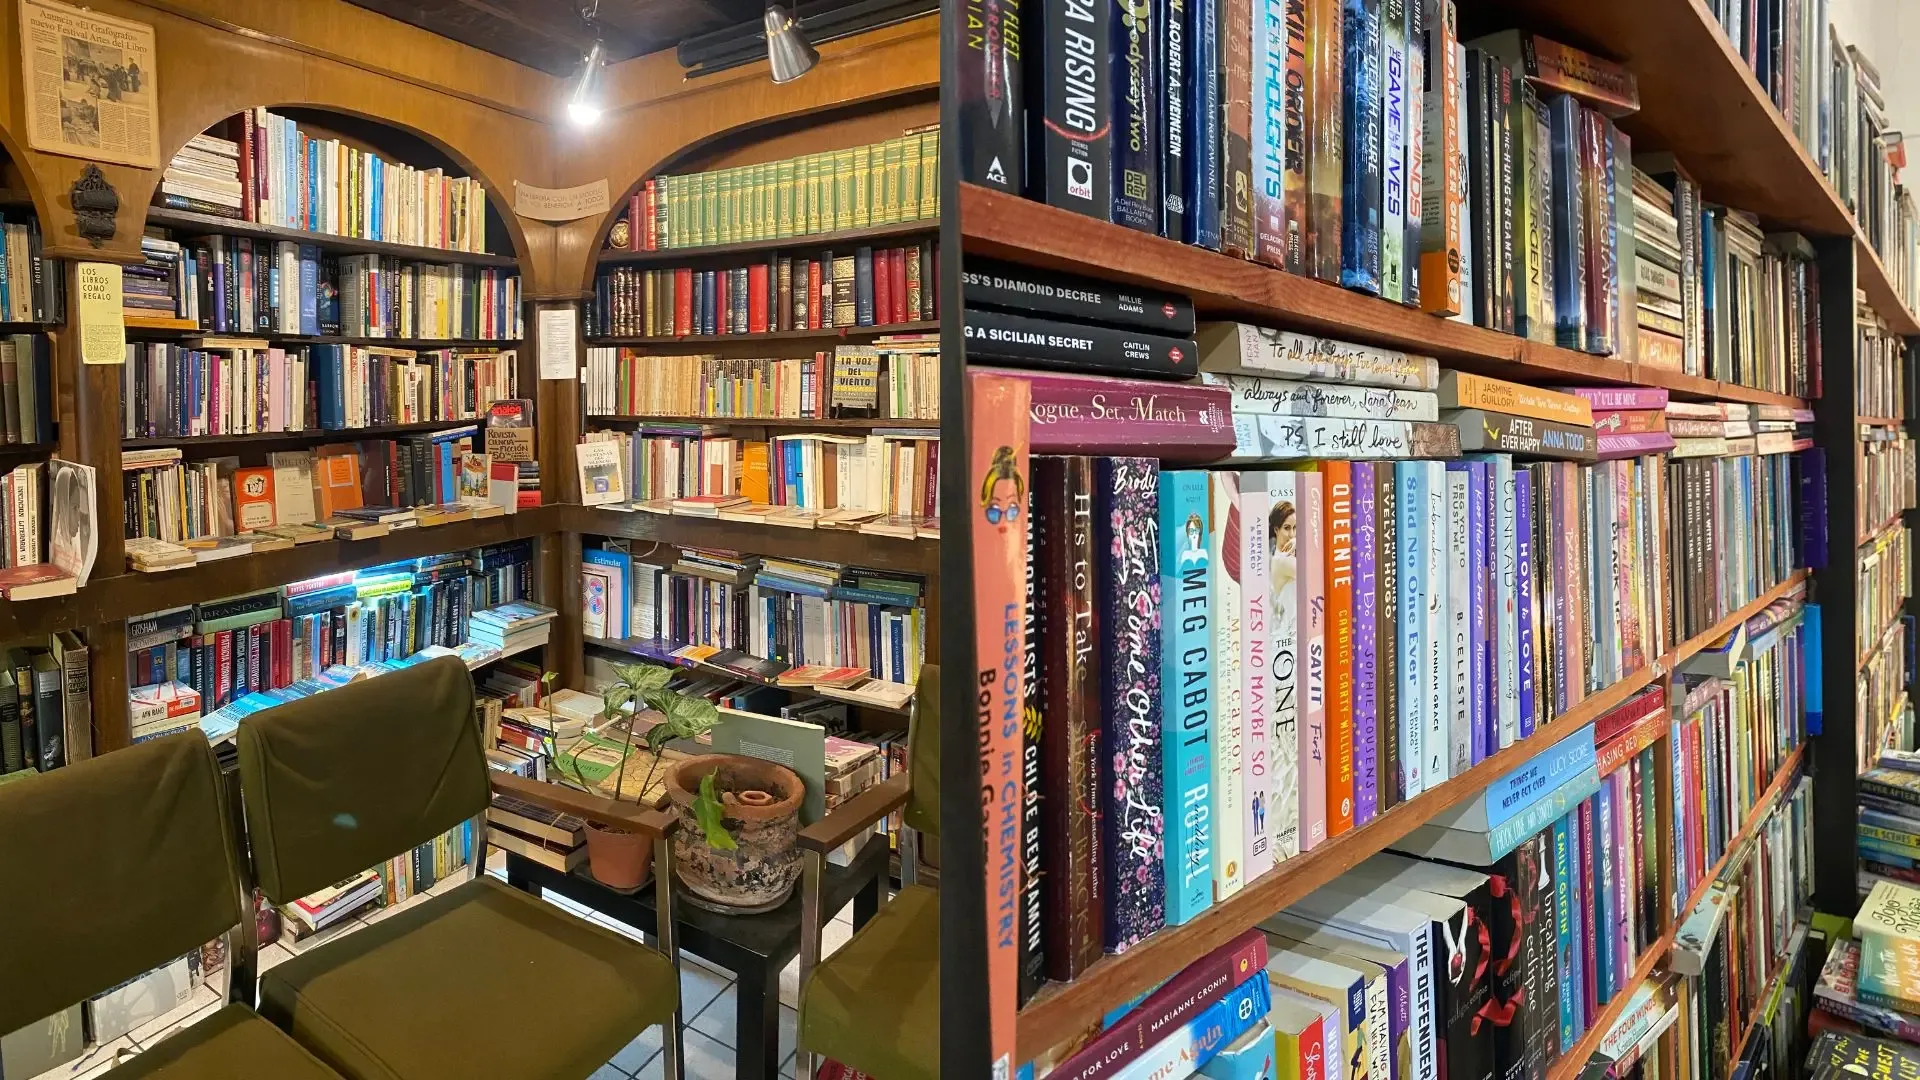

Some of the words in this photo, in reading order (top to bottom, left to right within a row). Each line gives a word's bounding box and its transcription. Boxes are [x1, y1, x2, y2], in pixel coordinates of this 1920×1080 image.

[57, 23, 88, 39] Festival
[112, 39, 124, 48] del
[126, 42, 147, 53] Libro
[1368, 12, 1379, 51] THE
[1065, 28, 1096, 134] RISING
[1368, 53, 1379, 118] DEATH
[1265, 47, 1281, 200] THOUGHTS
[1368, 121, 1379, 176] CURE
[1448, 115, 1457, 193] PLAYER
[986, 172, 1008, 185] ACE
[1069, 186, 1091, 199] orbit
[1126, 171, 1147, 187] DEL
[1126, 185, 1147, 199] REY
[1504, 152, 1512, 205] HUNGER
[1125, 214, 1148, 226] BOOKS
[1449, 200, 1457, 242] ONE
[1504, 207, 1512, 270] GAMES
[82, 276, 109, 285] LIBROS
[82, 284, 105, 292] COMO
[83, 292, 111, 300] REGALO
[994, 277, 1054, 296] DIAMOND
[1056, 286, 1101, 304] DECREE
[1118, 294, 1143, 305] MILLIE
[1118, 303, 1144, 314] ADAMS
[976, 327, 987, 339] A
[989, 329, 1046, 346] SICILIAN
[1048, 335, 1094, 351] SECRET
[1122, 341, 1150, 351] CAITLIN
[1124, 350, 1150, 360] CREWS
[841, 357, 852, 366] LA
[856, 357, 872, 366] VOZ
[848, 368, 862, 376] DEL
[840, 378, 871, 386] VIENTO
[1482, 382, 1513, 397] JASMINE
[1243, 384, 1288, 412] always
[1290, 391, 1307, 404] and
[1312, 390, 1356, 412] forever,
[1361, 389, 1386, 413] Lara
[1384, 389, 1418, 418] Jean
[1481, 393, 1516, 408] GUILLORY
[488, 429, 517, 439] REVISTA
[1314, 428, 1326, 449] I
[1331, 420, 1367, 451] still
[1371, 421, 1403, 450] love
[1501, 434, 1518, 450] EVER
[1519, 437, 1541, 453] HAPPY
[1509, 419, 1533, 437] AFTER
[1542, 428, 1565, 449] ANNA
[1565, 433, 1585, 452] TODD
[1113, 465, 1157, 499] Brody
[1270, 489, 1294, 498] CASS
[1074, 492, 1091, 546] His
[1383, 482, 1391, 555] EVELYN
[1407, 476, 1417, 529] Said
[1488, 474, 1496, 547] JONATHAN
[1332, 483, 1351, 589] QUEENIE
[1408, 537, 1417, 568] No
[1453, 532, 1459, 552] ME
[594, 557, 622, 567] Estimular
[1459, 551, 1466, 568] TO
[1520, 542, 1529, 598] HOW
[1612, 521, 1620, 590] BLACK
[1074, 559, 1089, 590] to
[1384, 562, 1392, 619] HUGO
[204, 602, 264, 620] BRANDO
[1182, 568, 1207, 634] MEG
[1250, 594, 1264, 632] YES
[1310, 595, 1325, 629] You
[1408, 575, 1418, 624] One
[1521, 607, 1529, 620] to
[131, 622, 157, 636] GRISHAM
[1127, 589, 1153, 682] Some
[1456, 611, 1464, 626] B.
[1075, 601, 1092, 683] Take
[1275, 637, 1293, 649] THE
[1338, 609, 1349, 665] CANDICE
[1002, 603, 1019, 740] LESSONS
[1250, 640, 1264, 669] NO
[1310, 644, 1323, 683] SAY
[1408, 632, 1419, 687] Ever
[1522, 629, 1531, 692] LOVE
[1364, 648, 1375, 708] SOPHIE
[1457, 632, 1465, 721] CELESTE
[1183, 647, 1208, 747] CABOT
[1250, 675, 1265, 743] MAYBE
[1272, 650, 1296, 739] ONE
[1310, 685, 1323, 706] IT
[1090, 733, 1098, 752] New
[1126, 686, 1154, 786] Other
[1310, 722, 1323, 768] First
[1339, 672, 1350, 784] CARTY-WILLIAMS
[1001, 751, 1016, 777] in
[1090, 755, 1098, 780] York
[1251, 750, 1265, 777] SO
[1365, 716, 1376, 790] COUSENS
[1550, 756, 1567, 777] LUCY
[1568, 742, 1589, 765] SCORE
[1025, 745, 1038, 822] CHLOE
[1090, 782, 1098, 809] Times
[1090, 812, 1098, 867] Bestselling
[1121, 790, 1161, 860] Life
[1184, 783, 1210, 889] ROYAL
[1276, 826, 1297, 840] HARPER
[997, 782, 1017, 949] CHEMISTRY
[1557, 831, 1565, 877] EMILY
[1026, 825, 1041, 952] BENJAMIN
[1558, 882, 1567, 935] GIFFIN
[1871, 900, 1901, 926] Jojo
[1543, 890, 1556, 994] breaking
[1525, 934, 1537, 1013] eclipse
[1151, 998, 1195, 1033] MARIANNE
[1197, 974, 1228, 1000] CRONIN
[1369, 993, 1377, 1026] FUN
[1602, 1029, 1620, 1052] THE
[1618, 1016, 1636, 1038] FOUR
[1634, 999, 1657, 1024] WINDS
[1082, 1062, 1103, 1080] FOR
[1105, 1042, 1130, 1064] LOVE
[1854, 1047, 1870, 1066] THE
